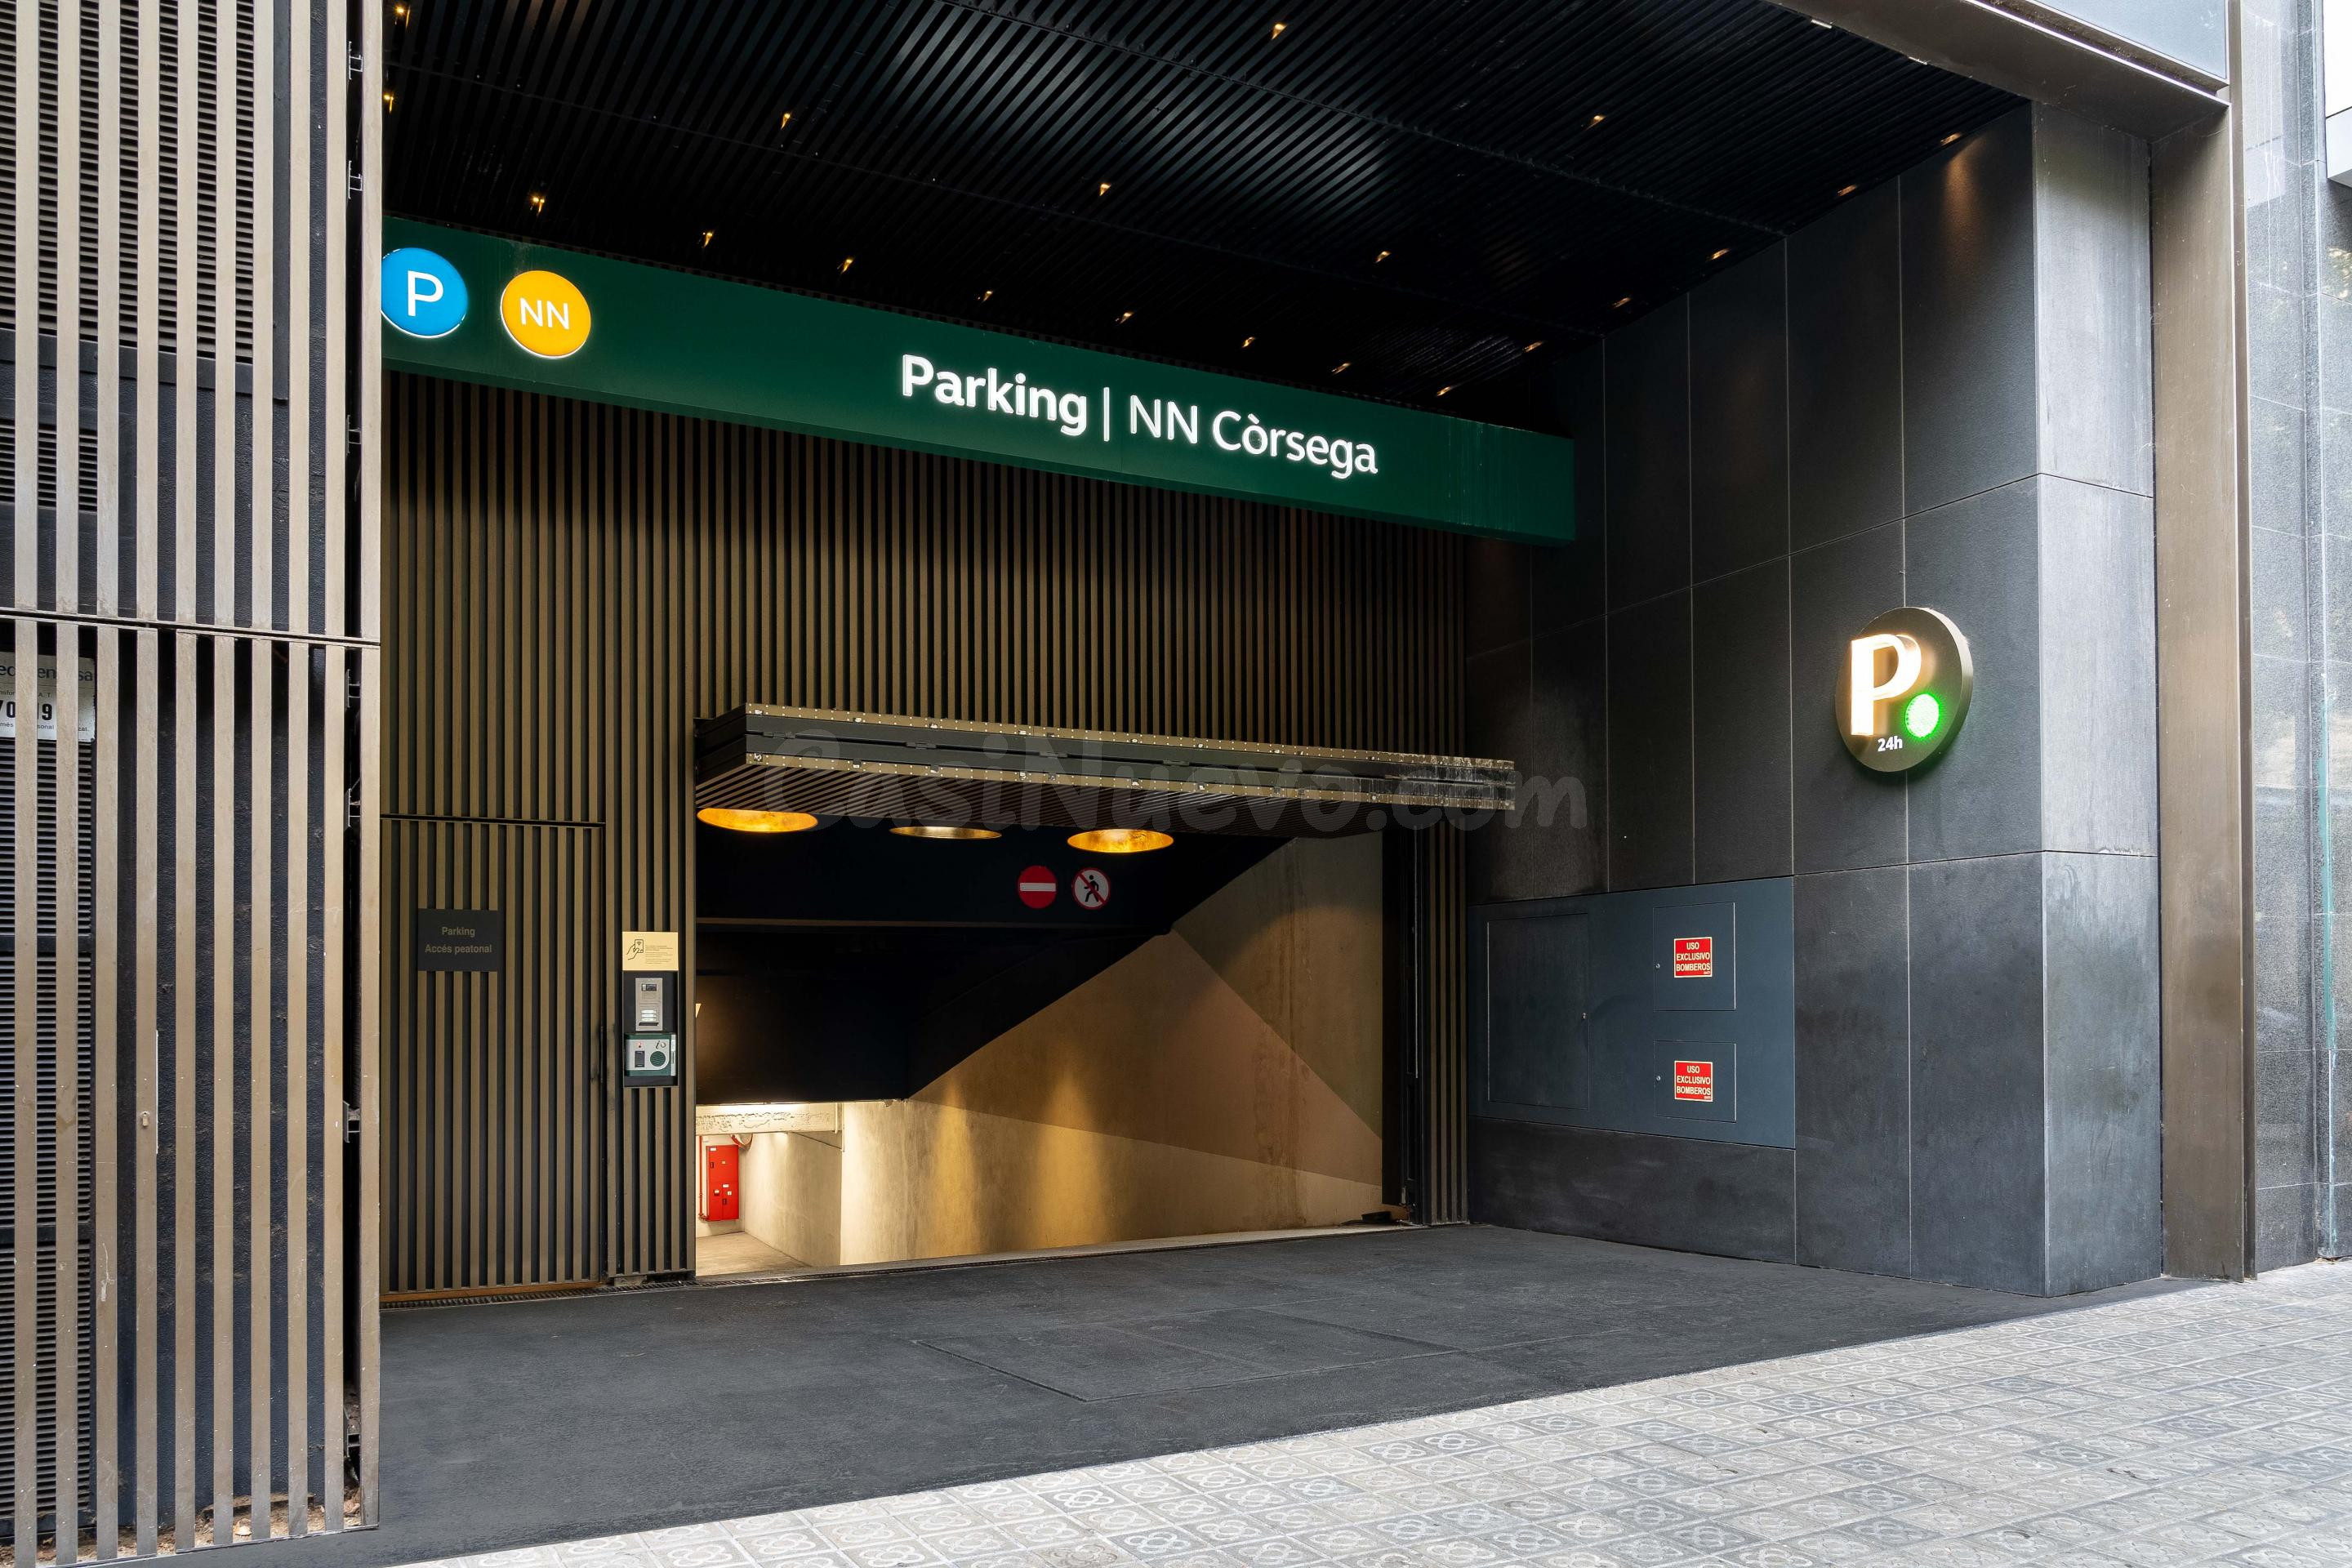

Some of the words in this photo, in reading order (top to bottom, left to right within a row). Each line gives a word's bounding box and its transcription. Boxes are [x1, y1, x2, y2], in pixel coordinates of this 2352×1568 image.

[407, 270, 444, 317] P
[519, 296, 570, 330] NN
[902, 354, 1088, 436] Parking
[1129, 394, 1199, 444] NN
[1212, 411, 1379, 479] Còrsega
[1851, 633, 1922, 737] P
[1878, 735, 1904, 752] 24h
[441, 926, 475, 938] Parking
[425, 944, 452, 953] Accés
[454, 944, 492, 956] peatonal
[1686, 942, 1700, 951] USO
[1676, 951, 1711, 961] EXCLUSIVO
[1676, 962, 1711, 972] BOMBEROS
[1686, 1065, 1700, 1074] USO
[1677, 1075, 1711, 1085] EXCLUSIVO
[1676, 1085, 1711, 1096] BOMBEROS
